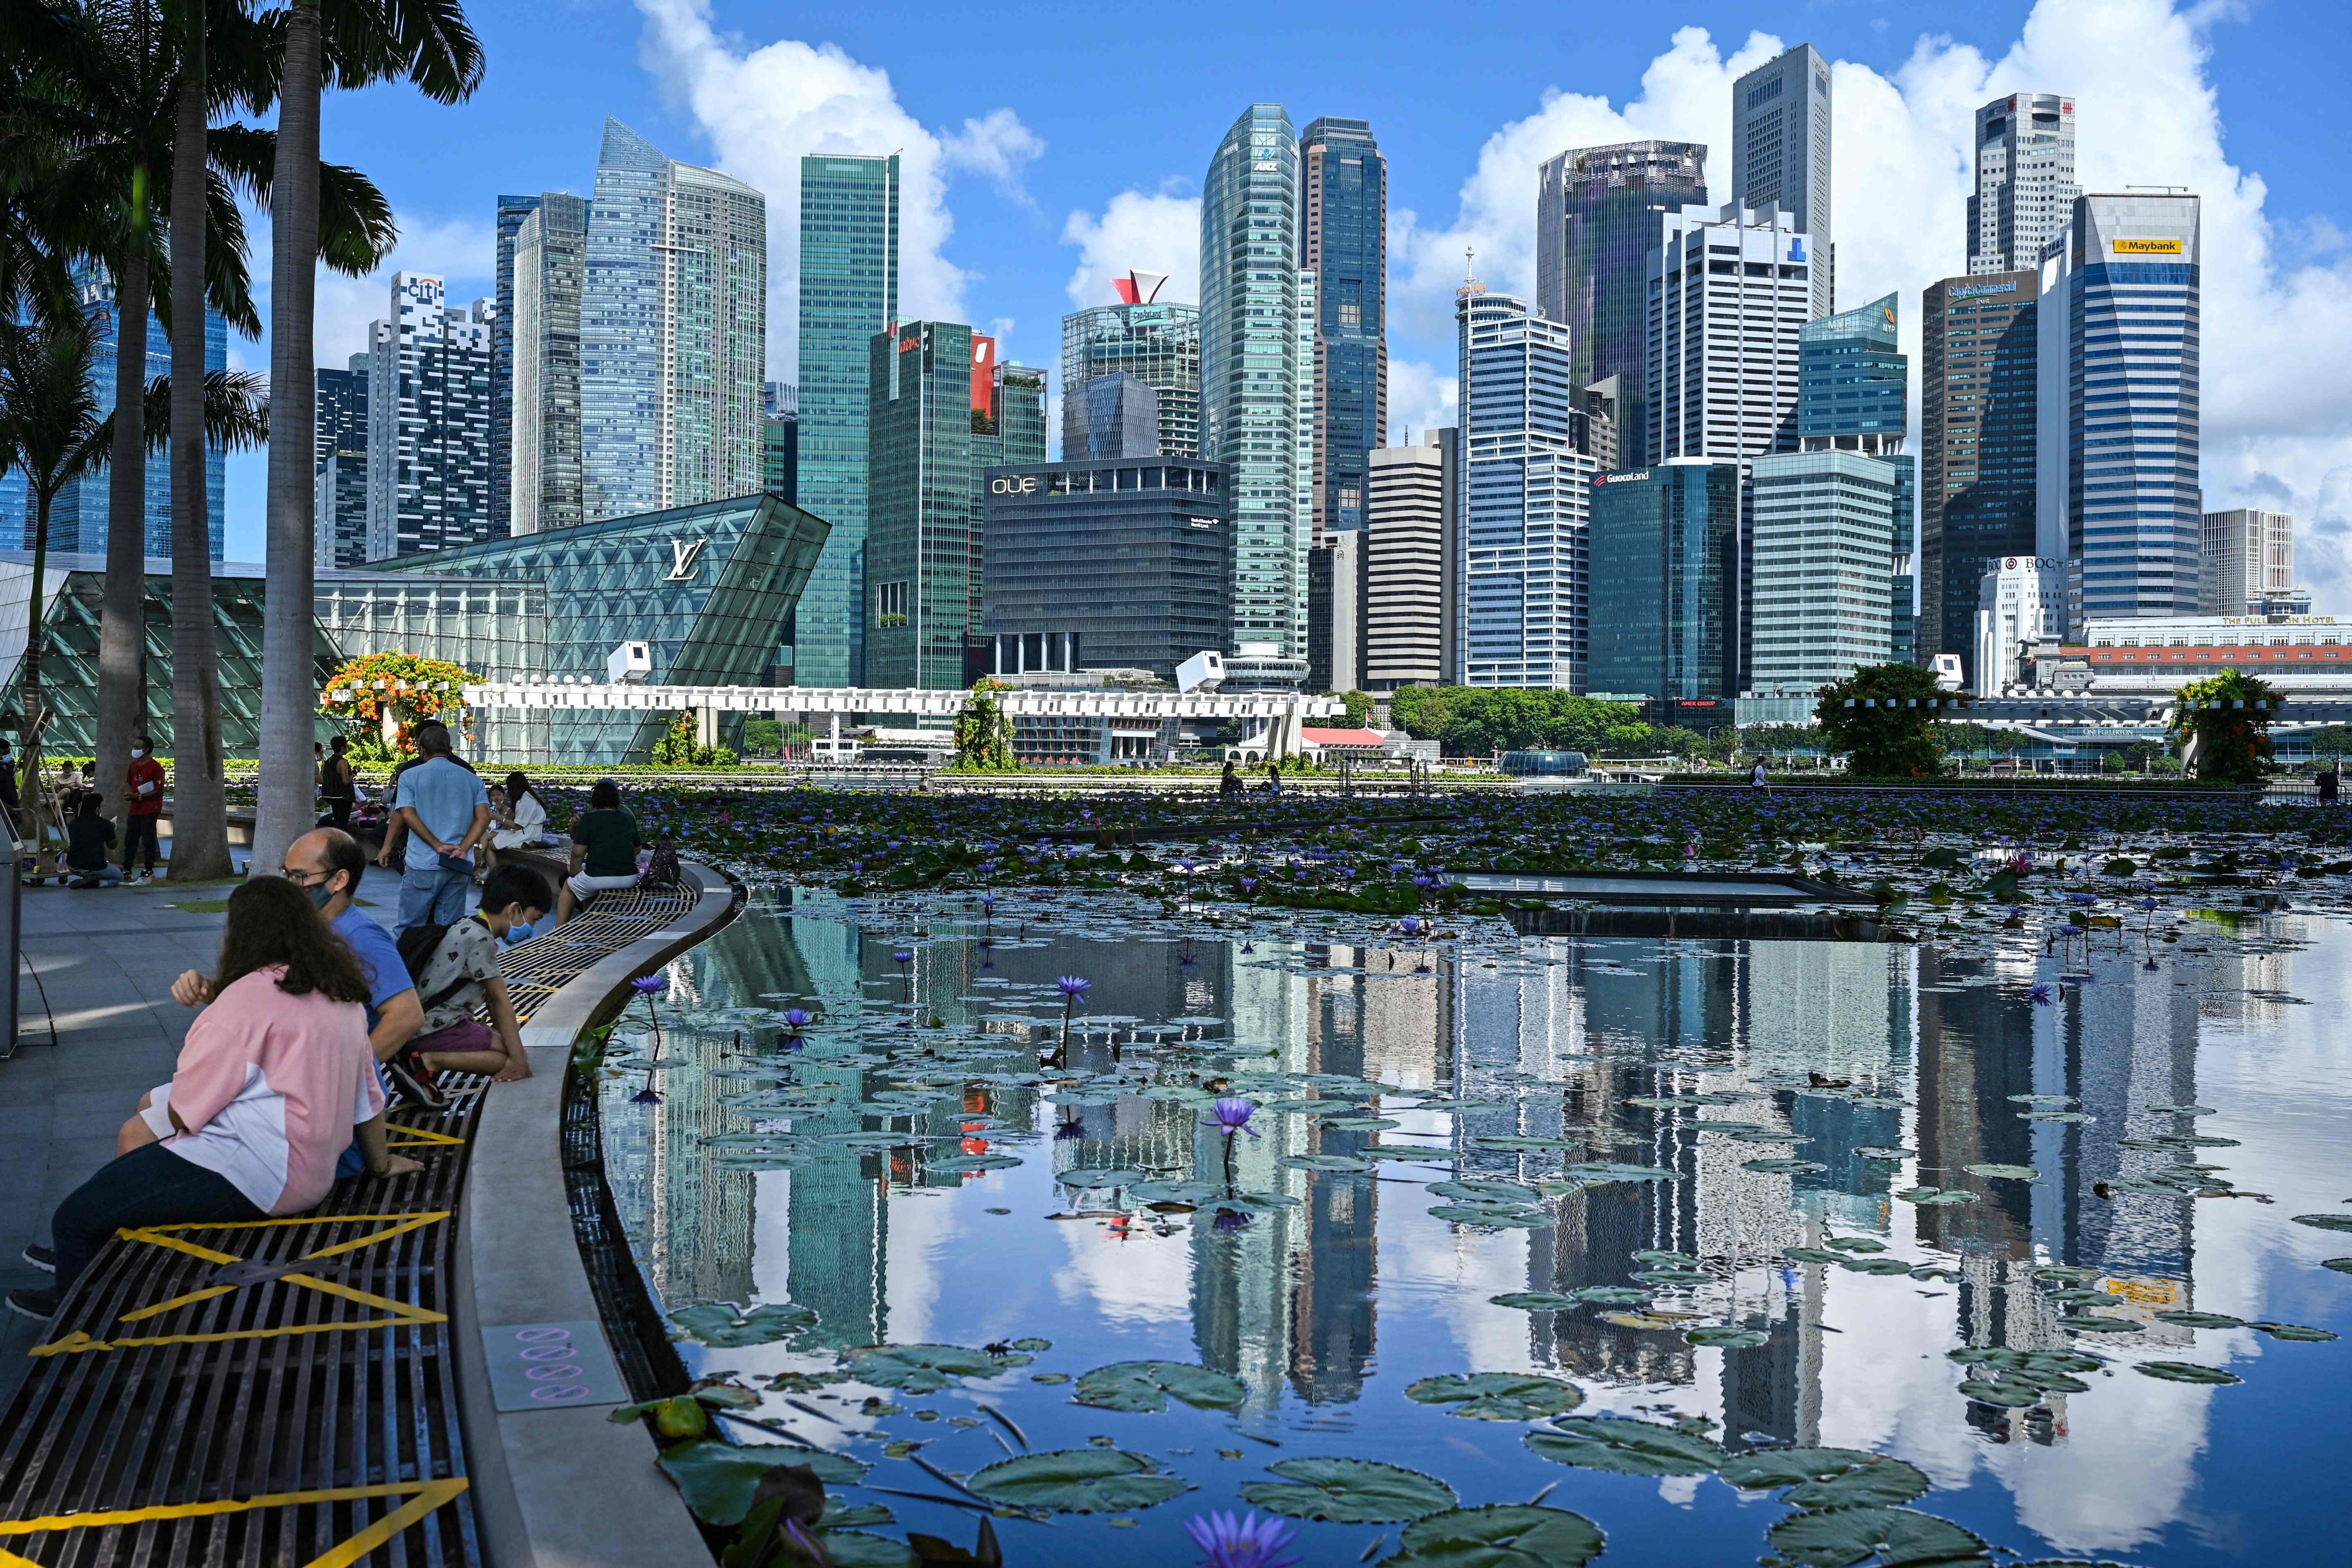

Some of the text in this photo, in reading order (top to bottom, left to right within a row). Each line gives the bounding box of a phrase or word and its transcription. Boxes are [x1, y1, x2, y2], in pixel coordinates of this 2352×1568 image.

[1254, 162, 1277, 171] ANZ
[2129, 241, 2176, 252] Maybank
[408, 283, 438, 299] citi
[1828, 319, 1851, 329] MYP
[1883, 323, 1895, 334] MYP
[1606, 471, 1649, 483] GuocoLand
[992, 477, 1036, 493] OUE
[1988, 559, 2000, 571] BOC
[2025, 558, 2054, 569] BOC
[2245, 616, 2299, 624] FULLON
[2303, 616, 2336, 624] HOTEL
